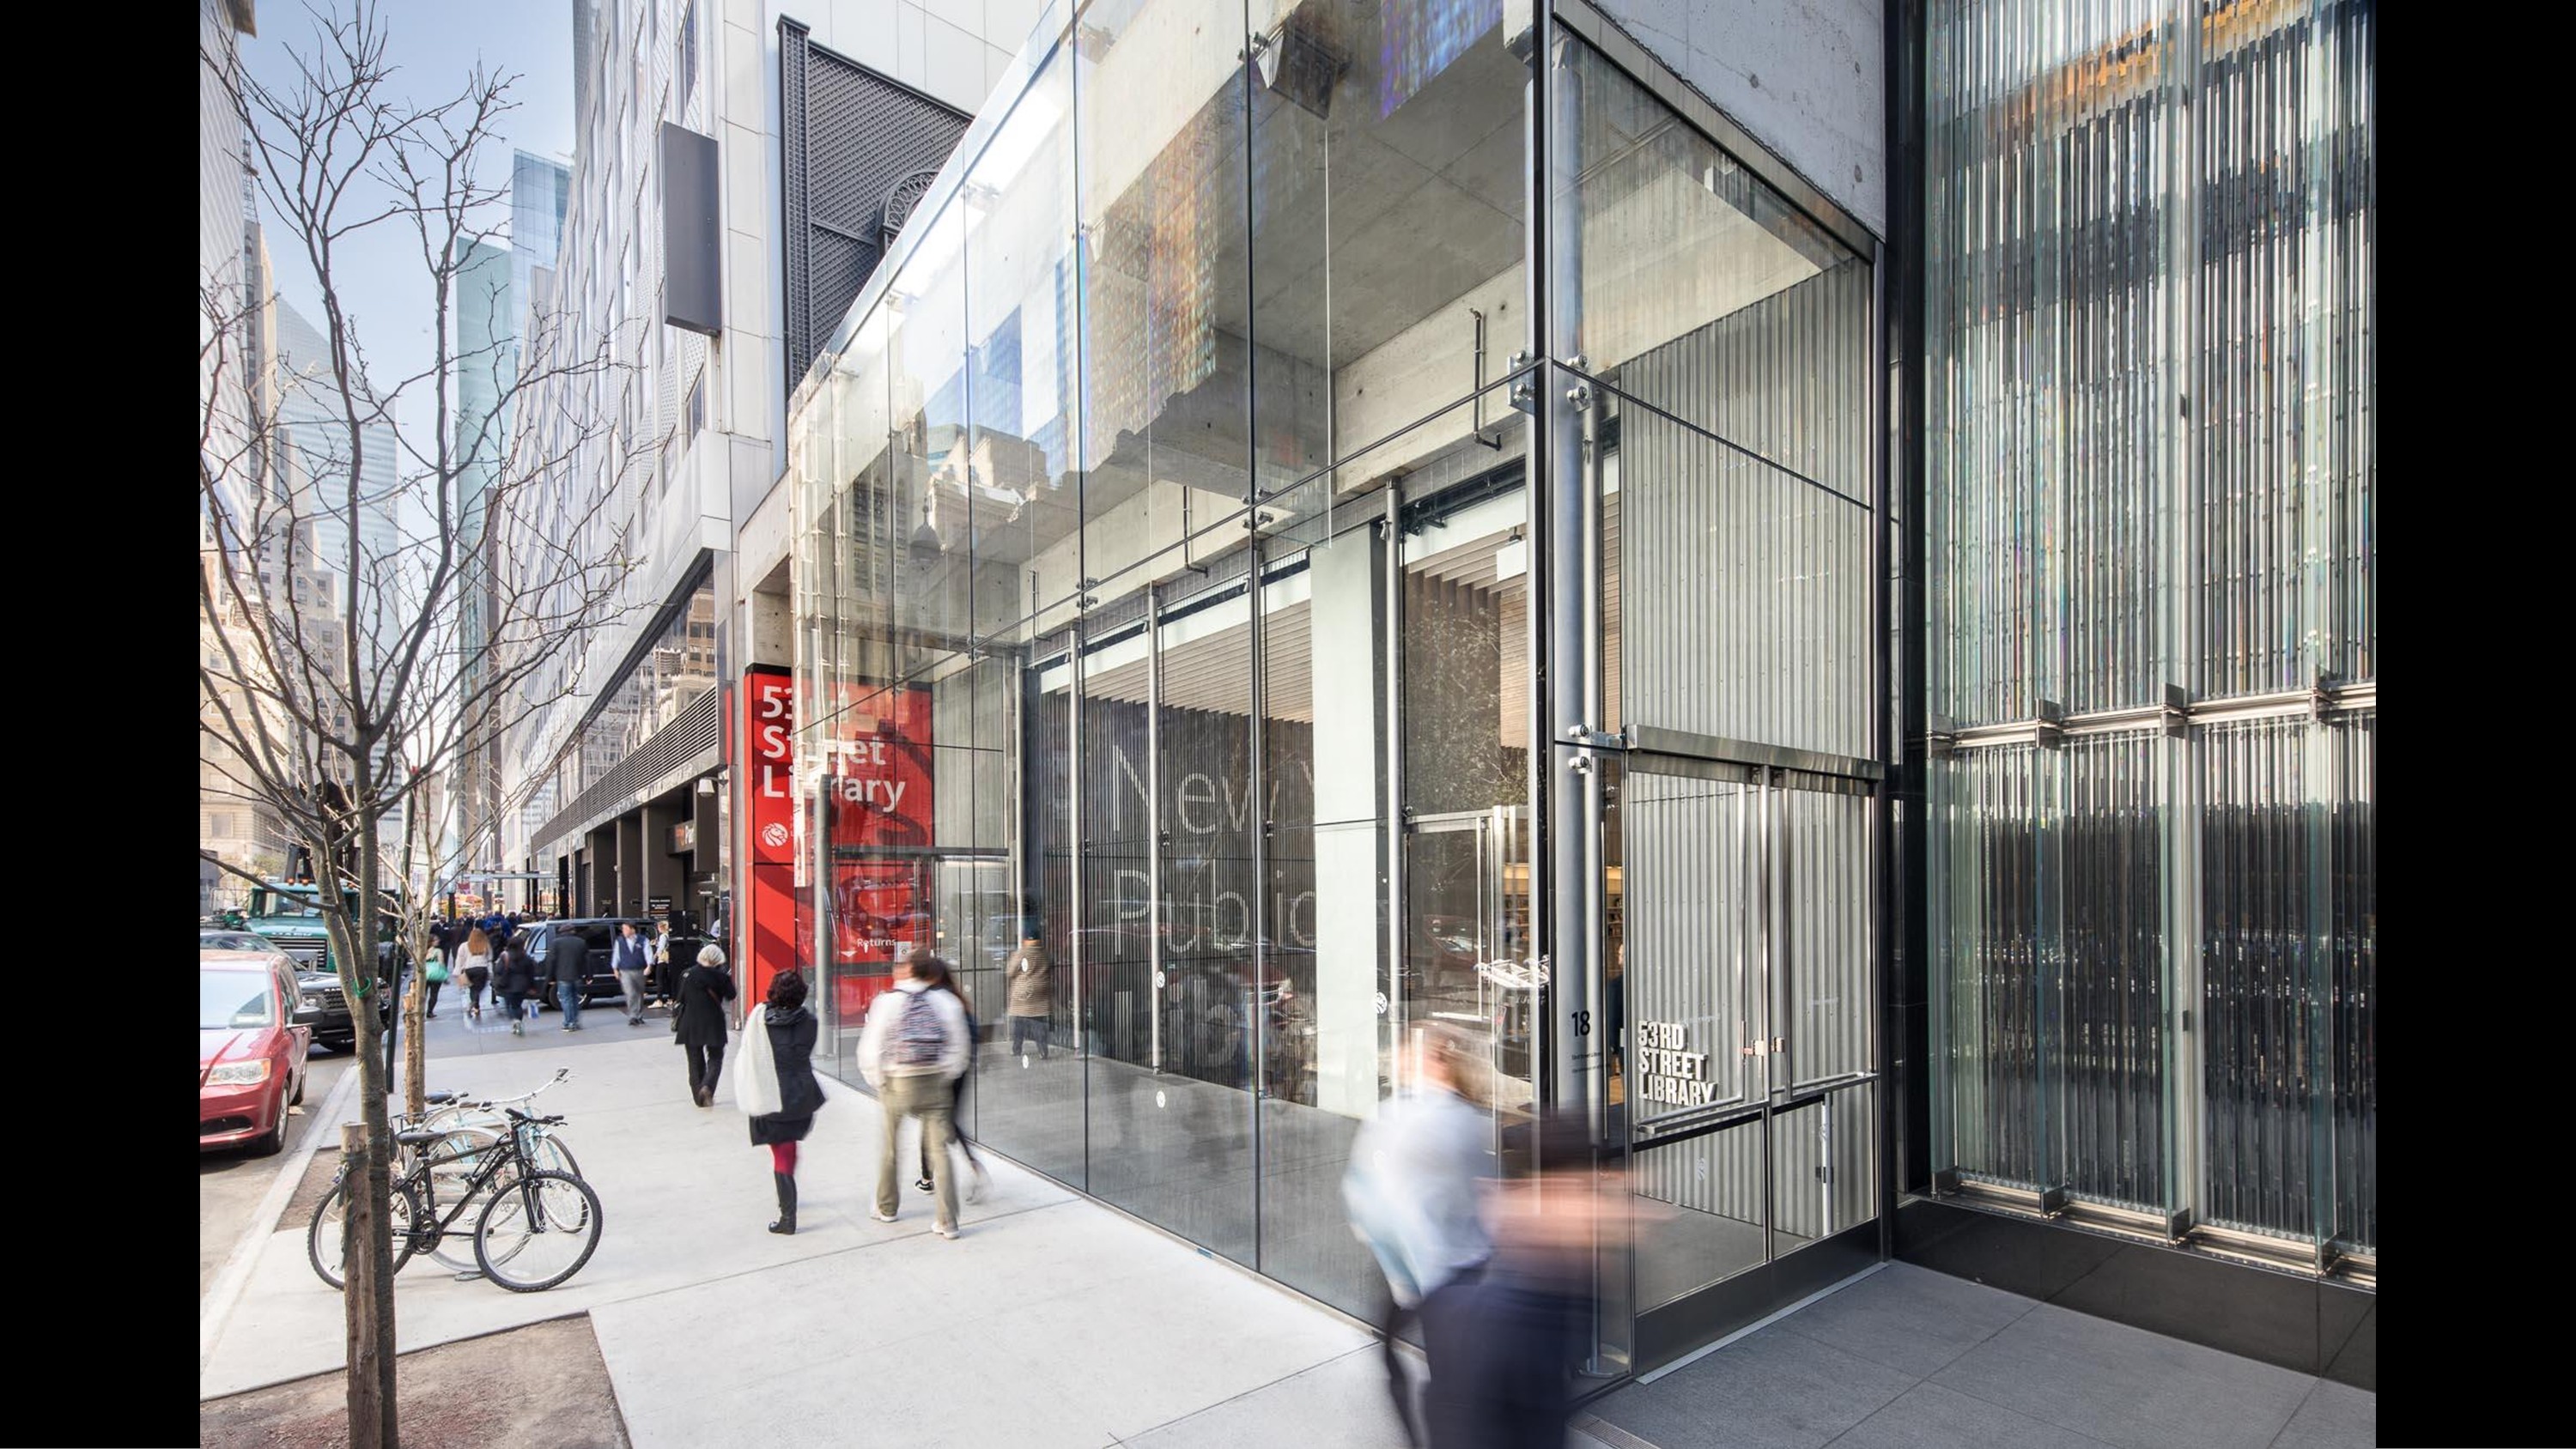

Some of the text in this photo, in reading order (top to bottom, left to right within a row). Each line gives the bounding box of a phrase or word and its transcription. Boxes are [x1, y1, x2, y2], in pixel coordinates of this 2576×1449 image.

[762, 725, 886, 765] Set
[763, 765, 906, 813] Lirary
[1113, 745, 1279, 834] New
[1115, 858, 1315, 955] Pubic
[1571, 1010, 1590, 1037] 18
[1637, 1020, 1686, 1050] 53RD
[1638, 1046, 1707, 1081] STREET
[1638, 1072, 1716, 1106] LIBRARY
